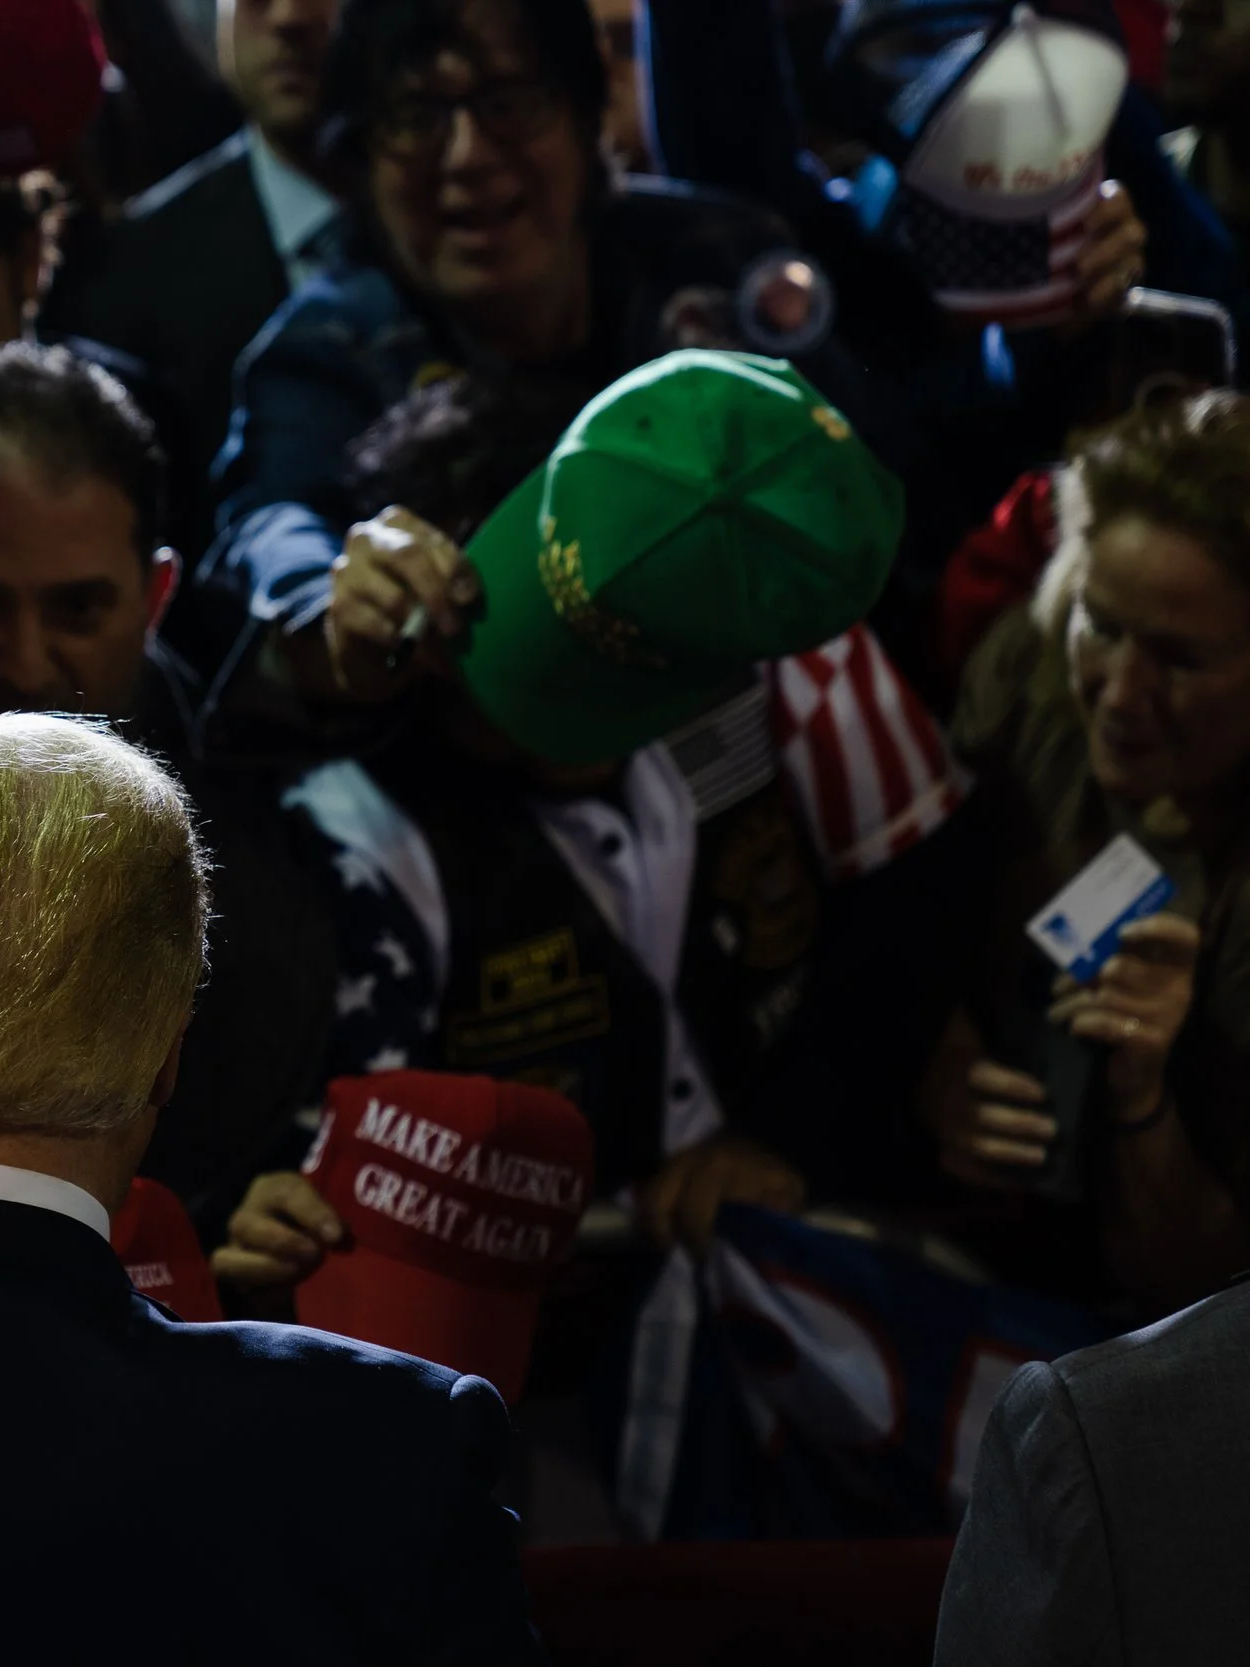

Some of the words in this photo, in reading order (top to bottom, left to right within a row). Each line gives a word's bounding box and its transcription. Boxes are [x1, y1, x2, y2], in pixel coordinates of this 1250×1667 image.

[354, 1097, 462, 1173] MAKE
[452, 1143, 584, 1214] AMERICA
[353, 1162, 469, 1242] GREAT
[462, 1213, 554, 1265] AGAIN
